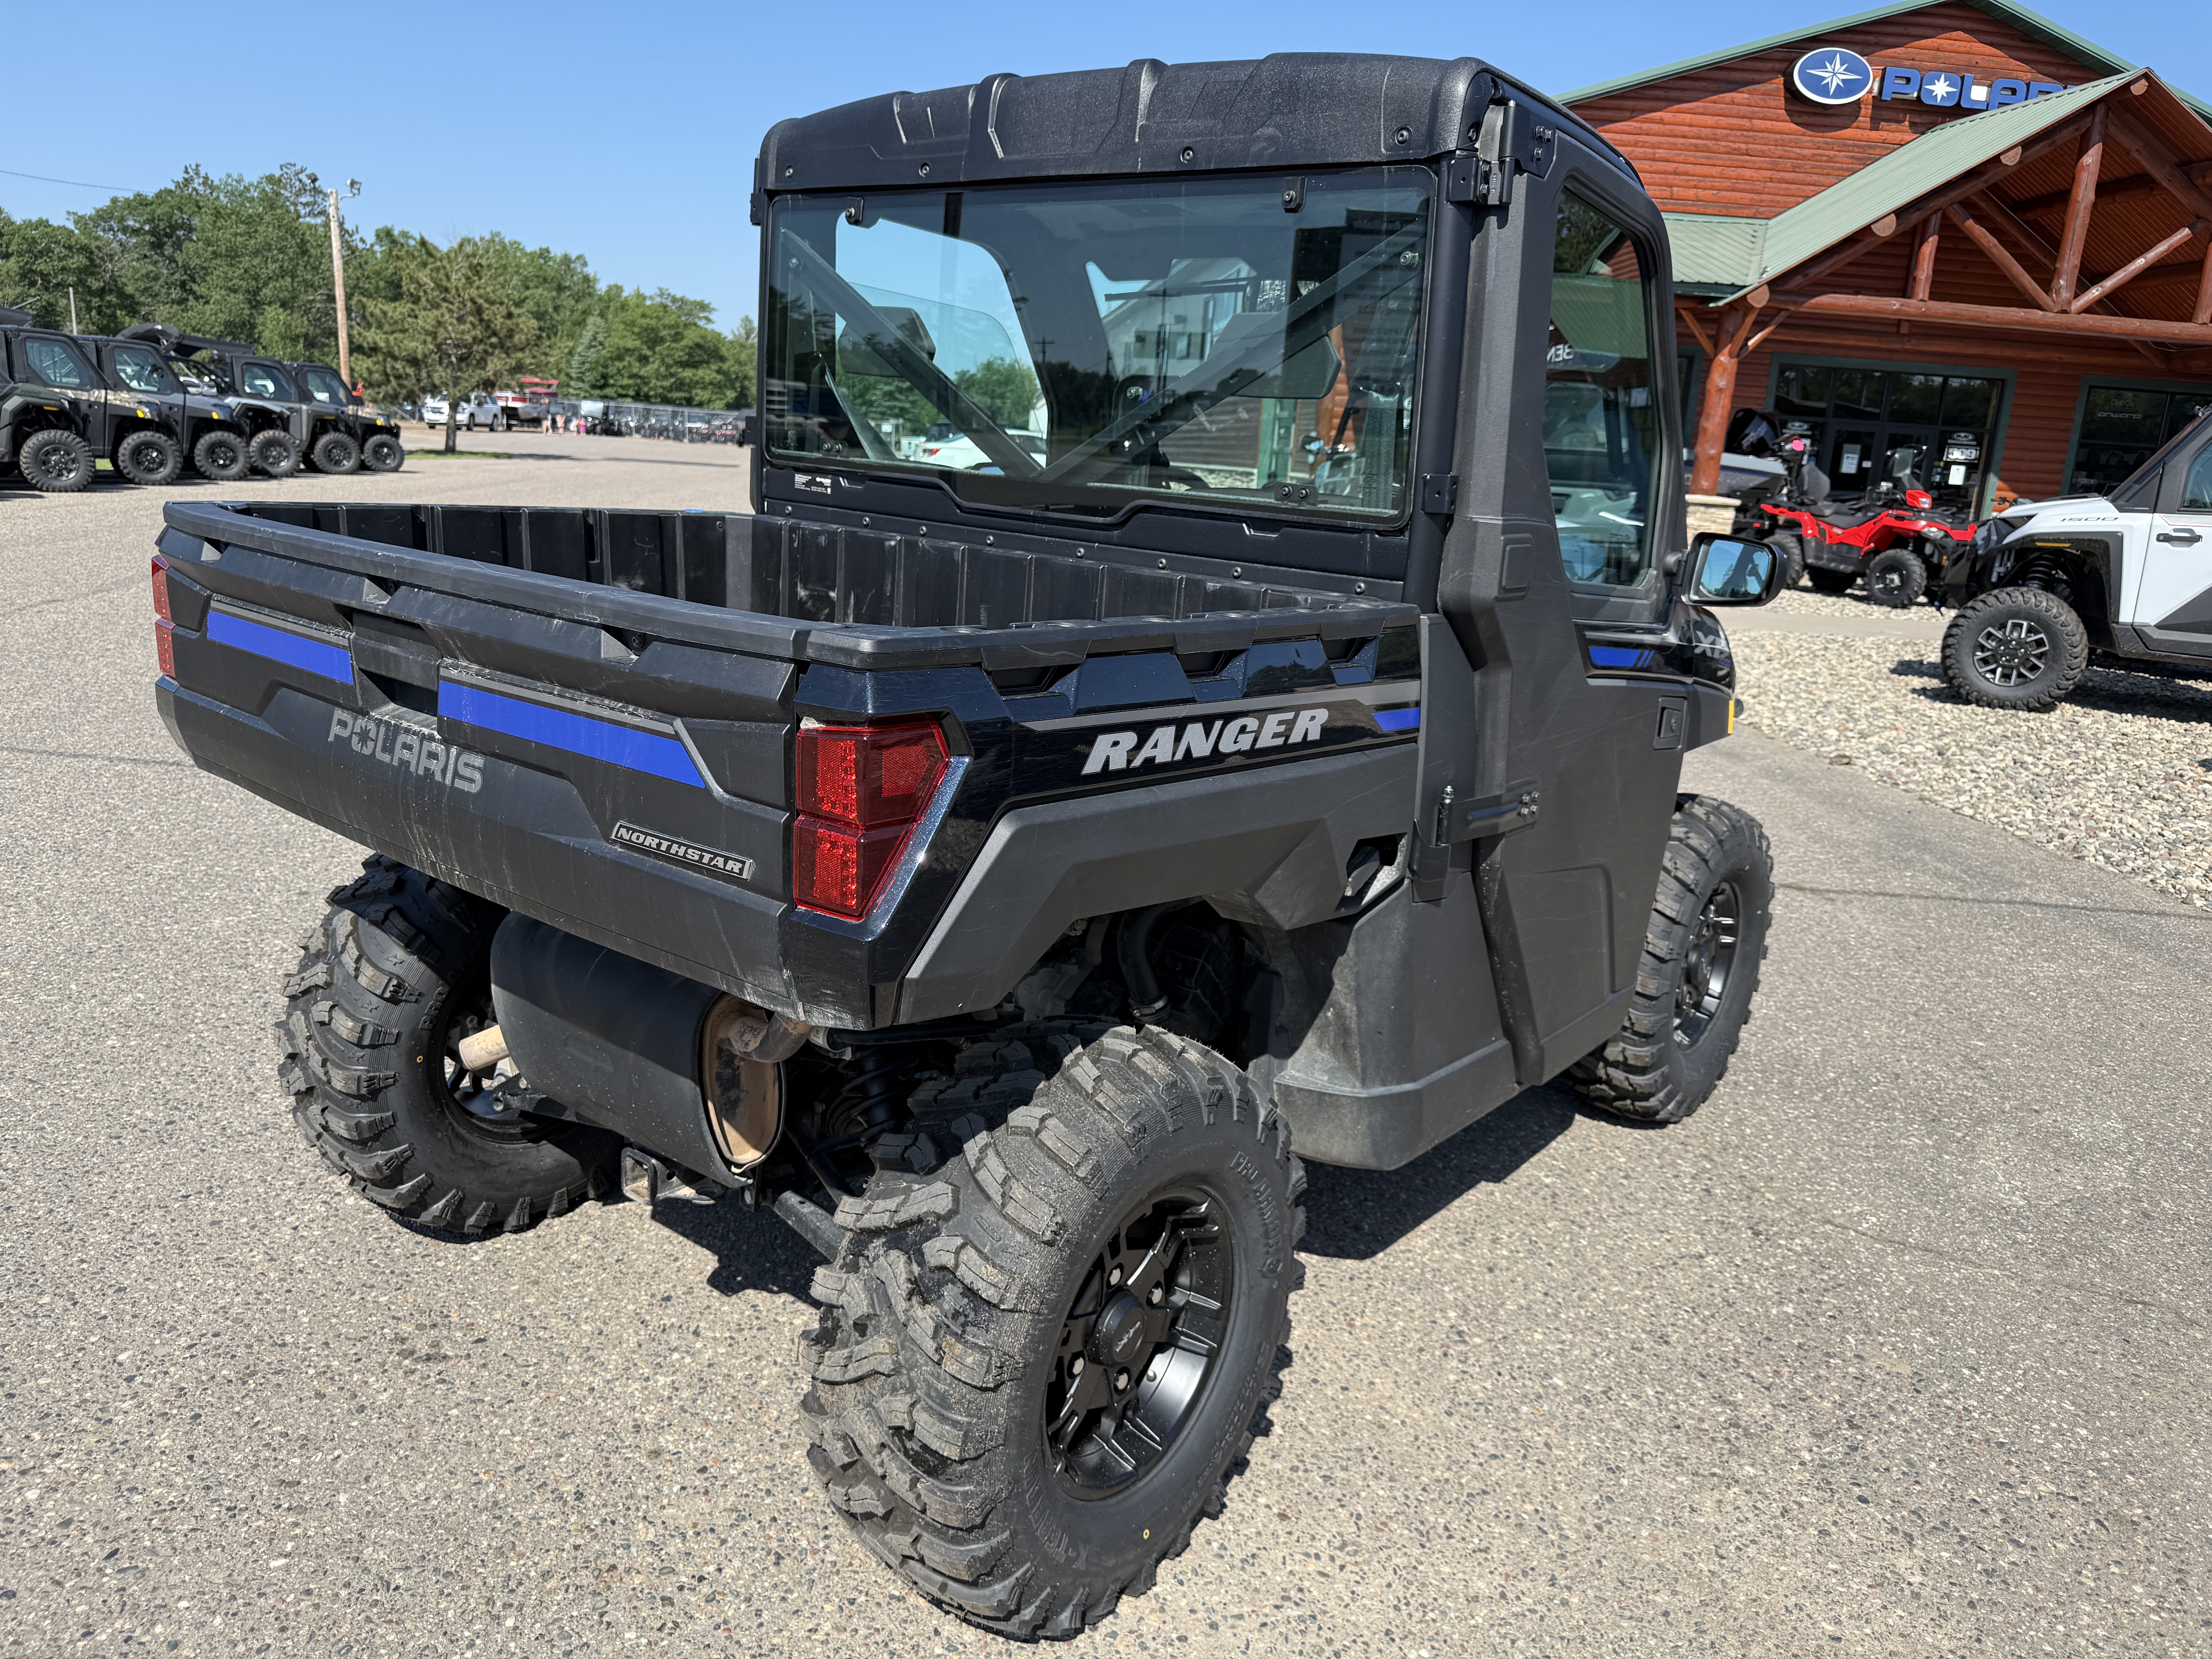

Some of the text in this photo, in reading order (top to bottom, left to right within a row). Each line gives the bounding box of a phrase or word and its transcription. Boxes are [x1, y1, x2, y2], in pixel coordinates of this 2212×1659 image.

[1881, 66, 2077, 111] POLA
[328, 708, 486, 794] POLARIS
[1081, 708, 1329, 775] RANGER
[617, 827, 743, 874] NORTHSTAR
[419, 986, 450, 1030] PRO
[1230, 1151, 1283, 1255] PRO ARMOR
